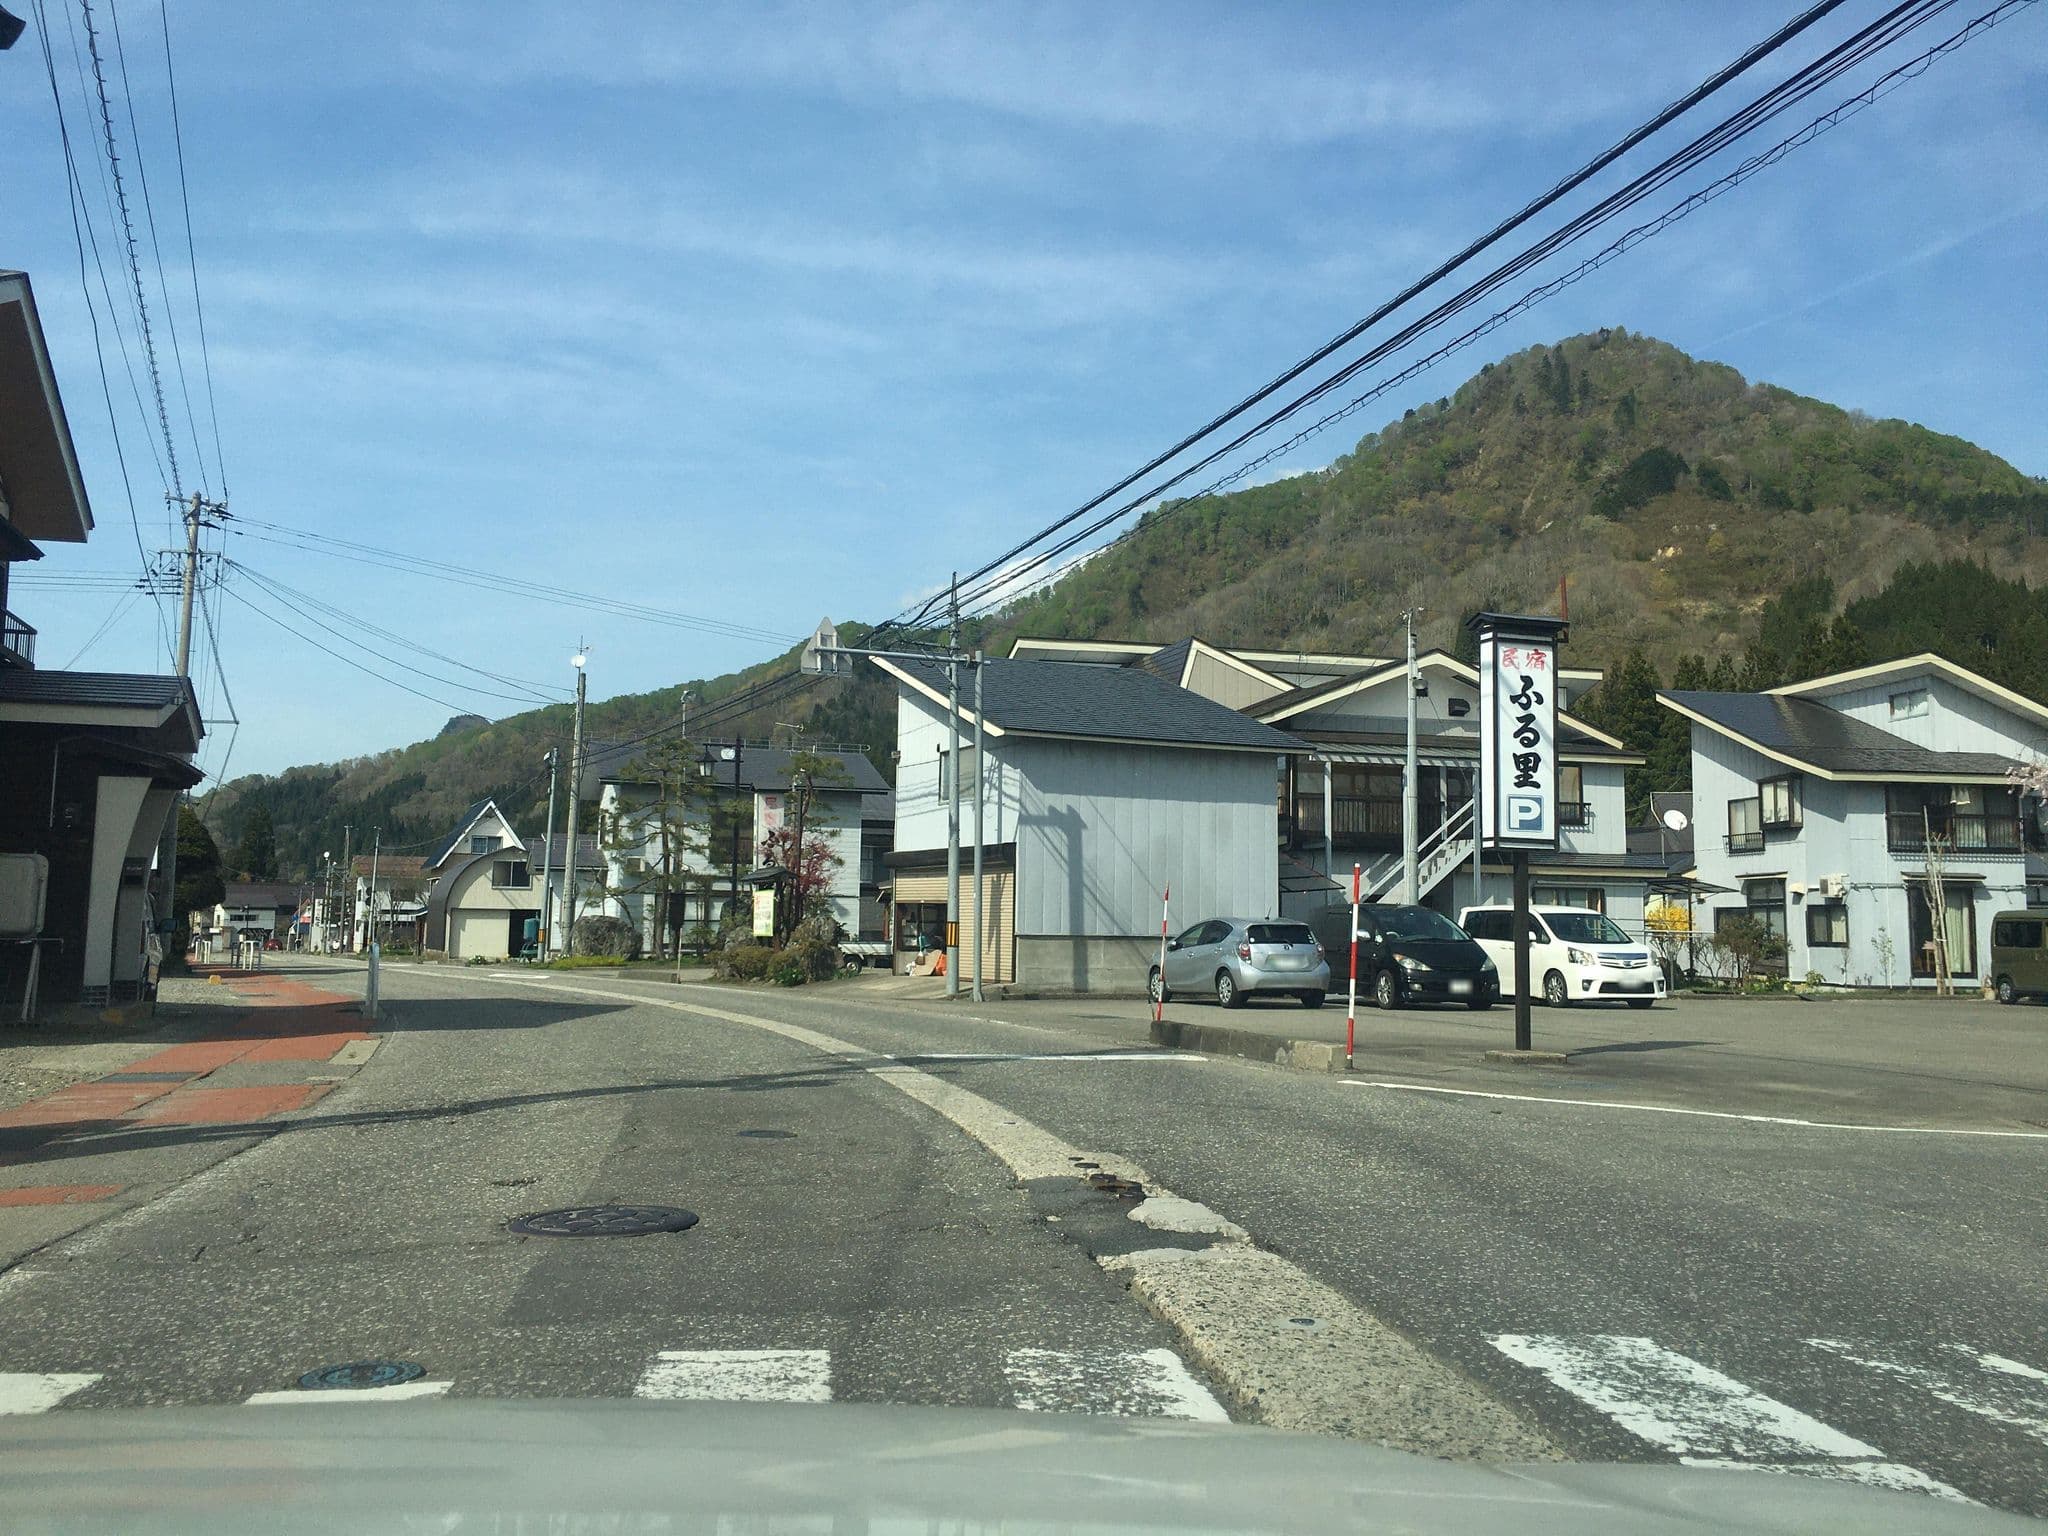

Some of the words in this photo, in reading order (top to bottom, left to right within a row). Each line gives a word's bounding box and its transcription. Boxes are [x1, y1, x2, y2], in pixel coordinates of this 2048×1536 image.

[1501, 648, 1547, 671] 民宿
[1510, 675, 1544, 789] ふる里
[1509, 798, 1541, 829] P
